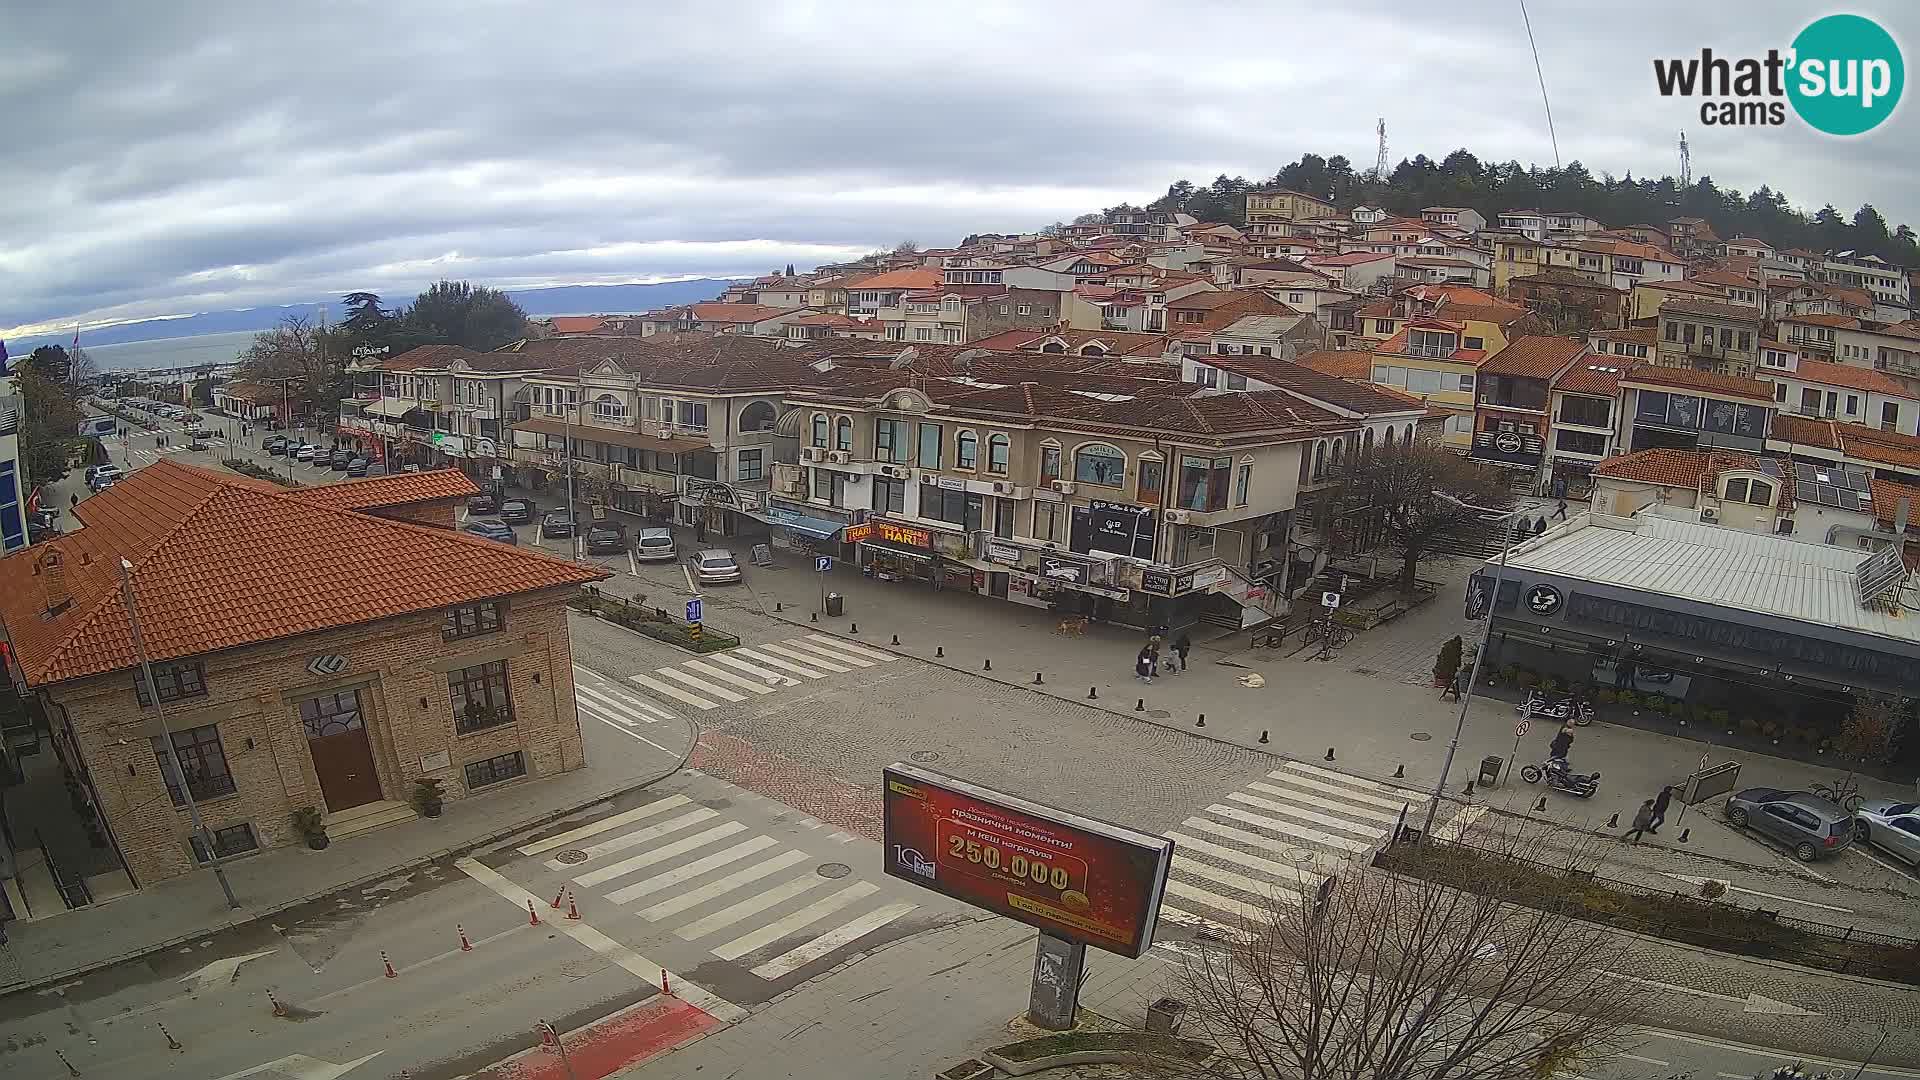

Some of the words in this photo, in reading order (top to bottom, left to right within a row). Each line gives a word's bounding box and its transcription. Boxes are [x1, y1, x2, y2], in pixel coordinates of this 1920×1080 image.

[819, 558, 828, 569] P
[951, 808, 1012, 832] празнични
[1015, 826, 1073, 850] моменти!
[949, 834, 1068, 890] 250.000
[1035, 906, 1044, 914] 10
